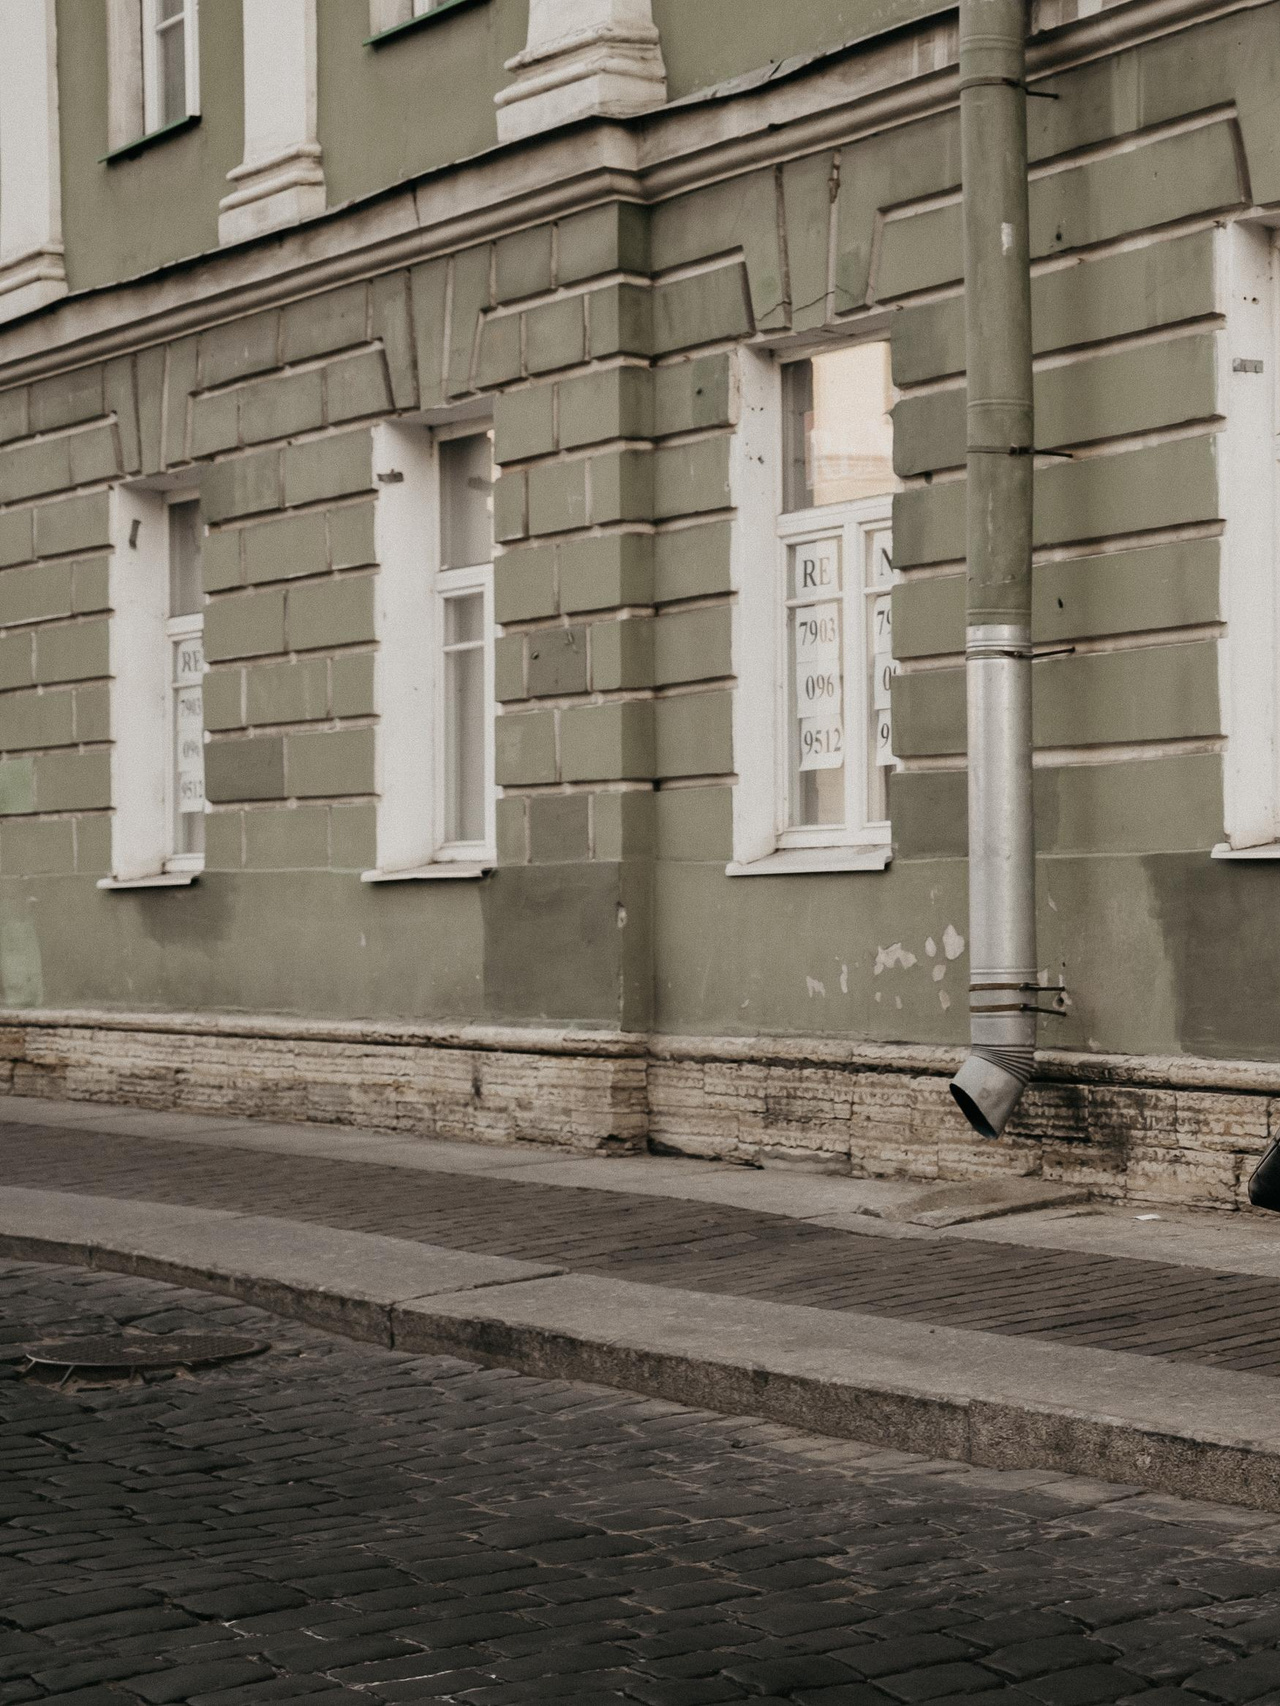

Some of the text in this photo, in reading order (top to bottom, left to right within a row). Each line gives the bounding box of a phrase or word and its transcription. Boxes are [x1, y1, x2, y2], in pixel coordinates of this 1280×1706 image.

[802, 557, 831, 588] RE
[799, 617, 836, 646] 7903
[806, 673, 834, 700] 096
[804, 727, 841, 755] 9512
